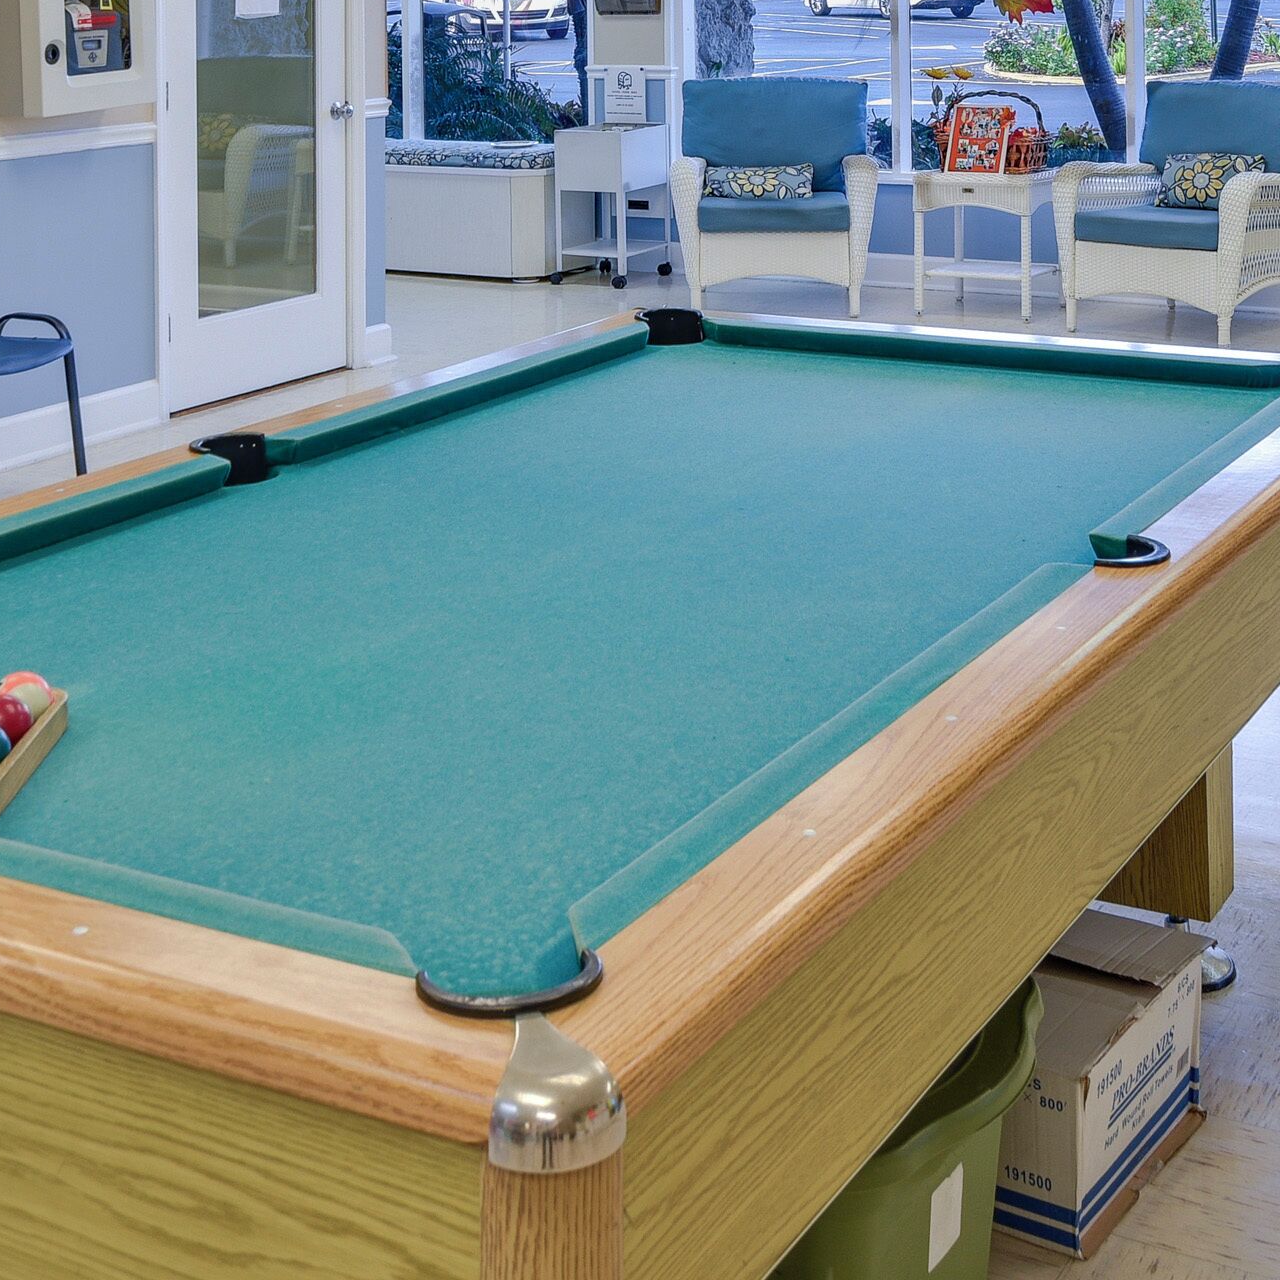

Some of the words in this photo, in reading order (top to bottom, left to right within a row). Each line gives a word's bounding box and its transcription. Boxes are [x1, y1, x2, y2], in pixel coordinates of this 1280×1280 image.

[1096, 1058, 1123, 1099] 191500
[1111, 1024, 1175, 1111] PRO-BRANDS
[1104, 1127, 1119, 1150] Hard
[1122, 1098, 1143, 1129] Wound
[1141, 1083, 1154, 1106] Roll
[1154, 1065, 1174, 1093] Towels
[1131, 1107, 1146, 1131] Kraft
[1004, 1165, 1052, 1192] 191500
